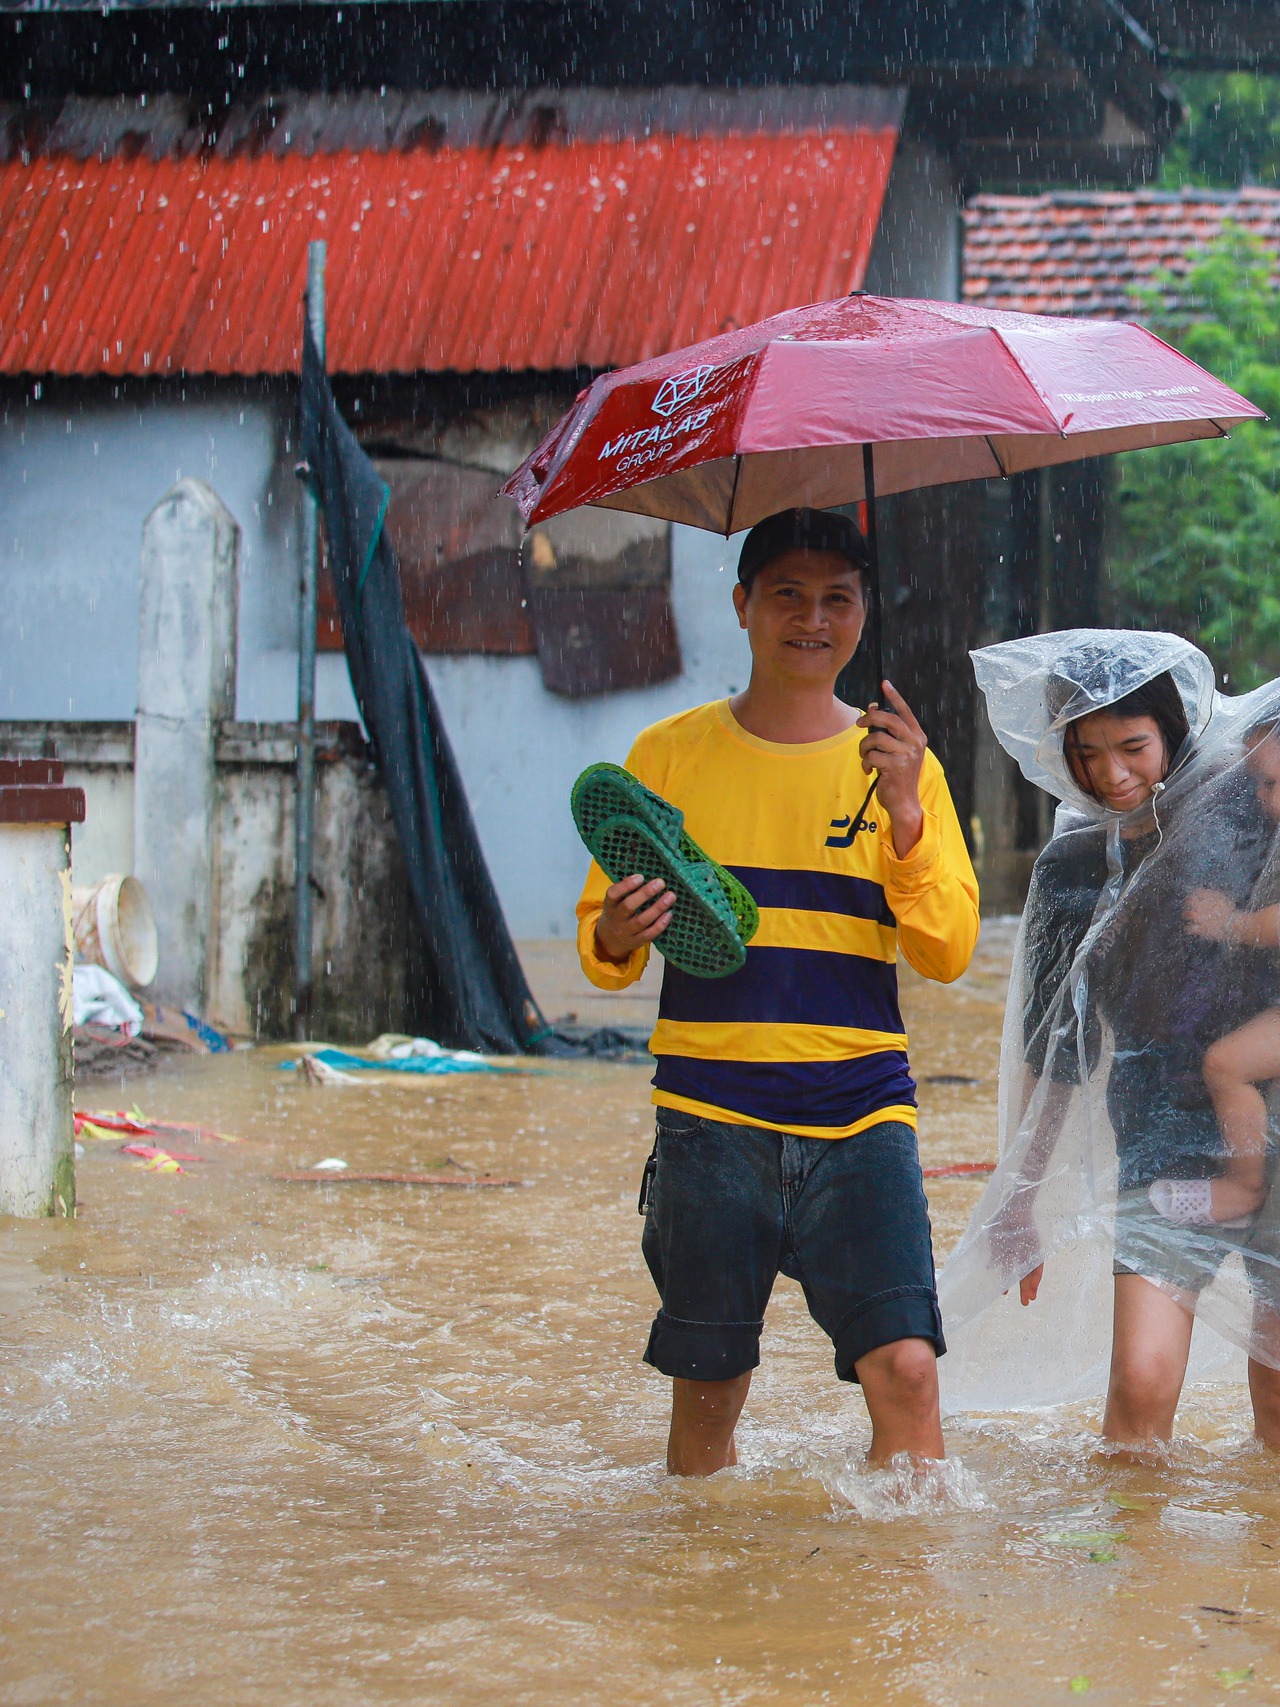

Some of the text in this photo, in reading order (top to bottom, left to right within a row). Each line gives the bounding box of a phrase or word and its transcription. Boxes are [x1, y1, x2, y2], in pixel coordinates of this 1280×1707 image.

[1119, 389, 1147, 400] High
[1153, 385, 1200, 397] sensitive
[597, 408, 714, 461] MITALAB
[616, 442, 673, 472] GROUP
